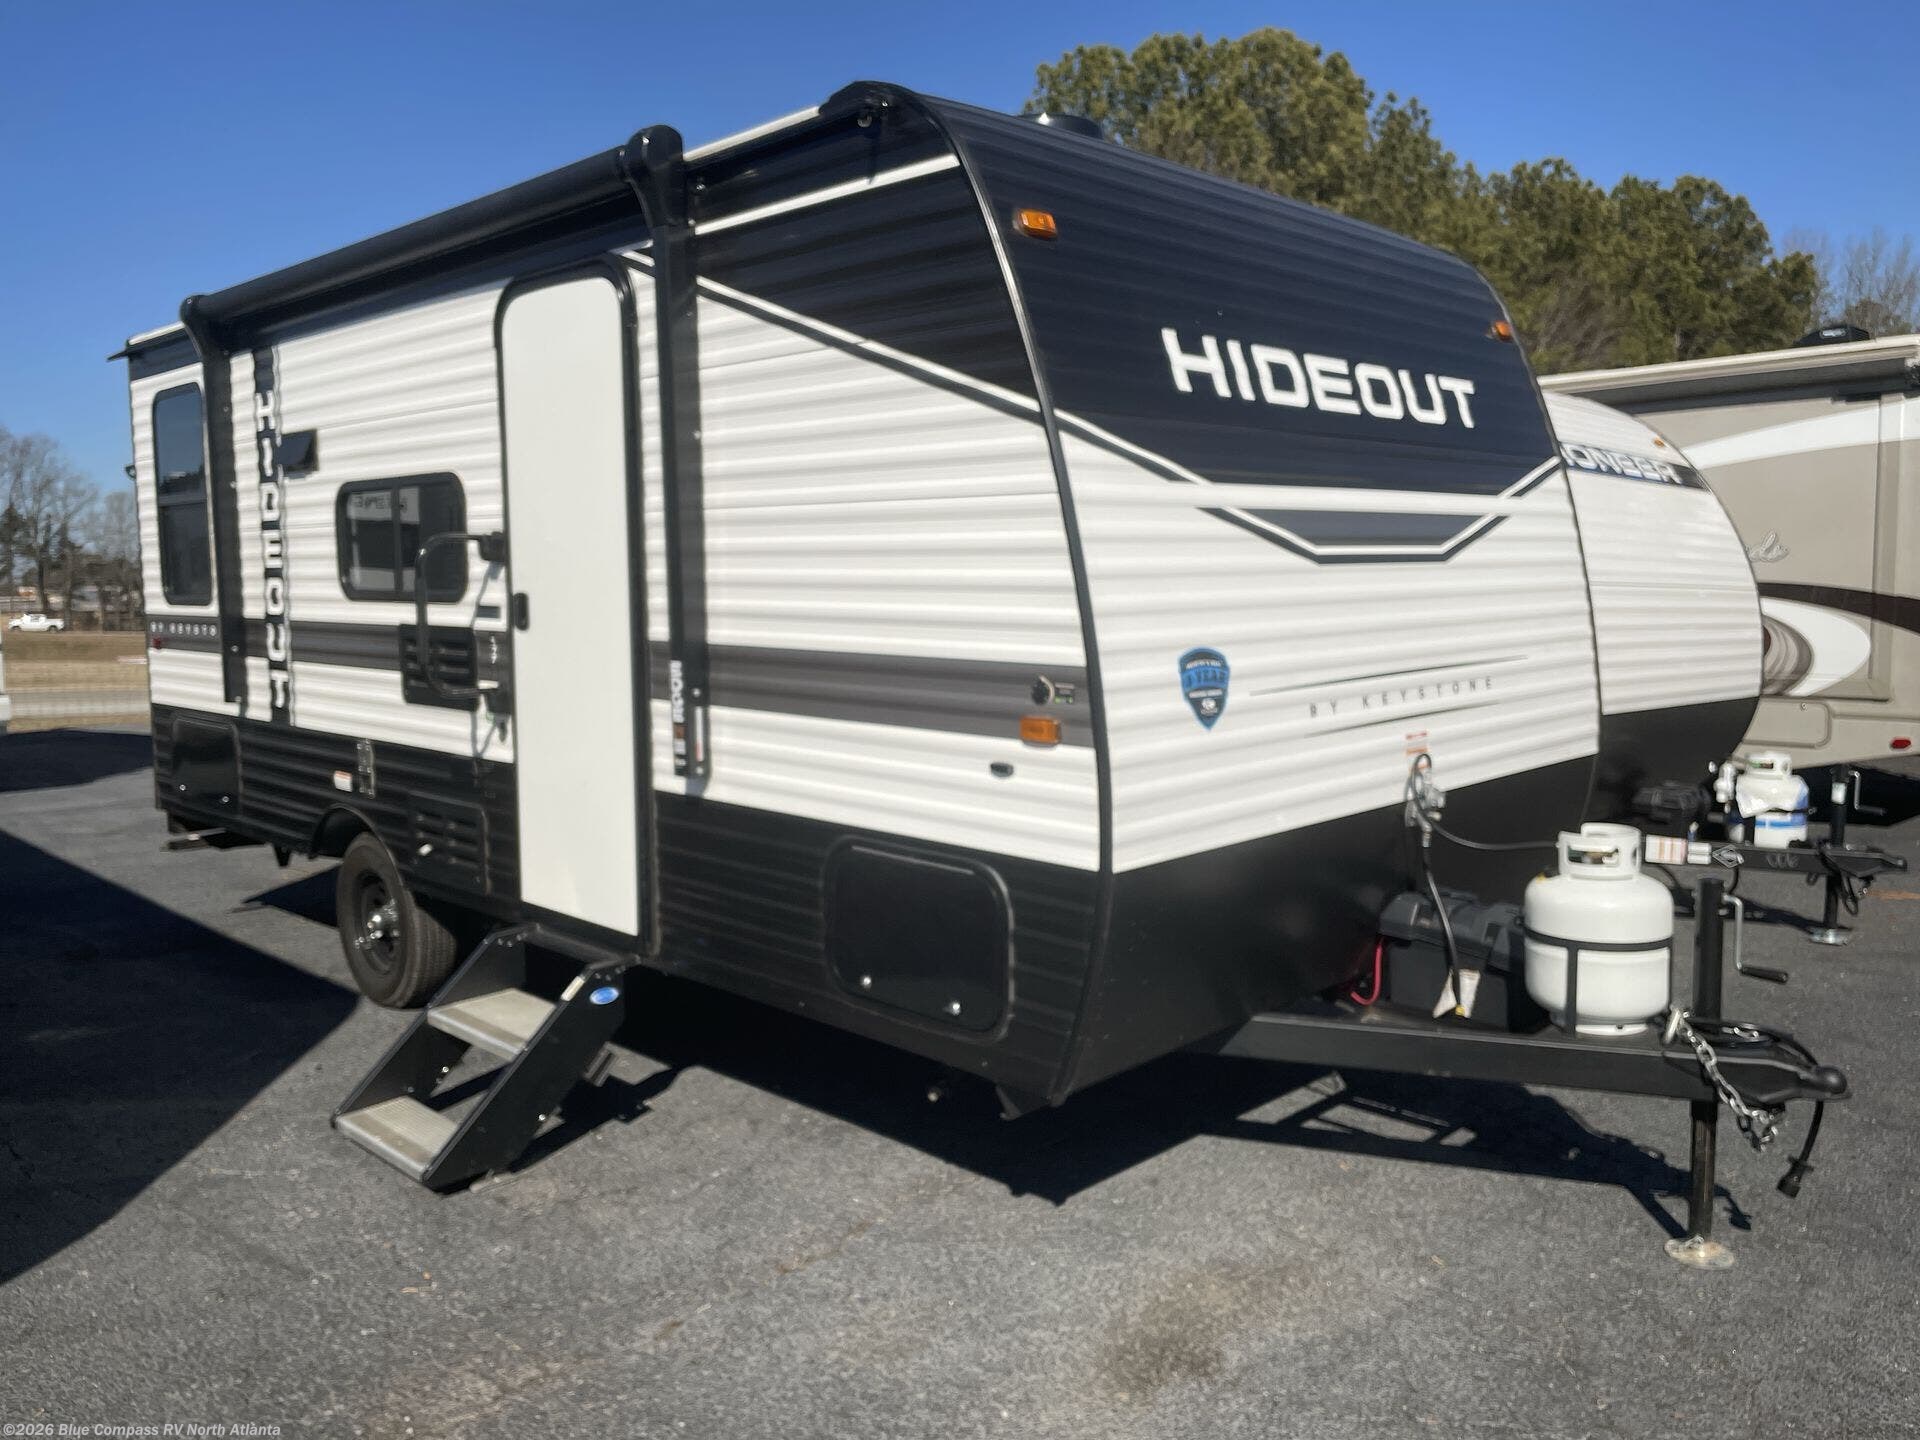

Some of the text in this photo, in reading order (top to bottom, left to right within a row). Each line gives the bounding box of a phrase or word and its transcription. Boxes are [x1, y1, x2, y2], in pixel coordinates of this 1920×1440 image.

[1161, 328, 1475, 428] HIDEOUT
[1560, 443, 1683, 484] IONEER
[255, 390, 289, 709] HIDEOUT
[168, 622, 217, 637] KEYSTO
[1310, 676, 1492, 718] BY KEYSTONE
